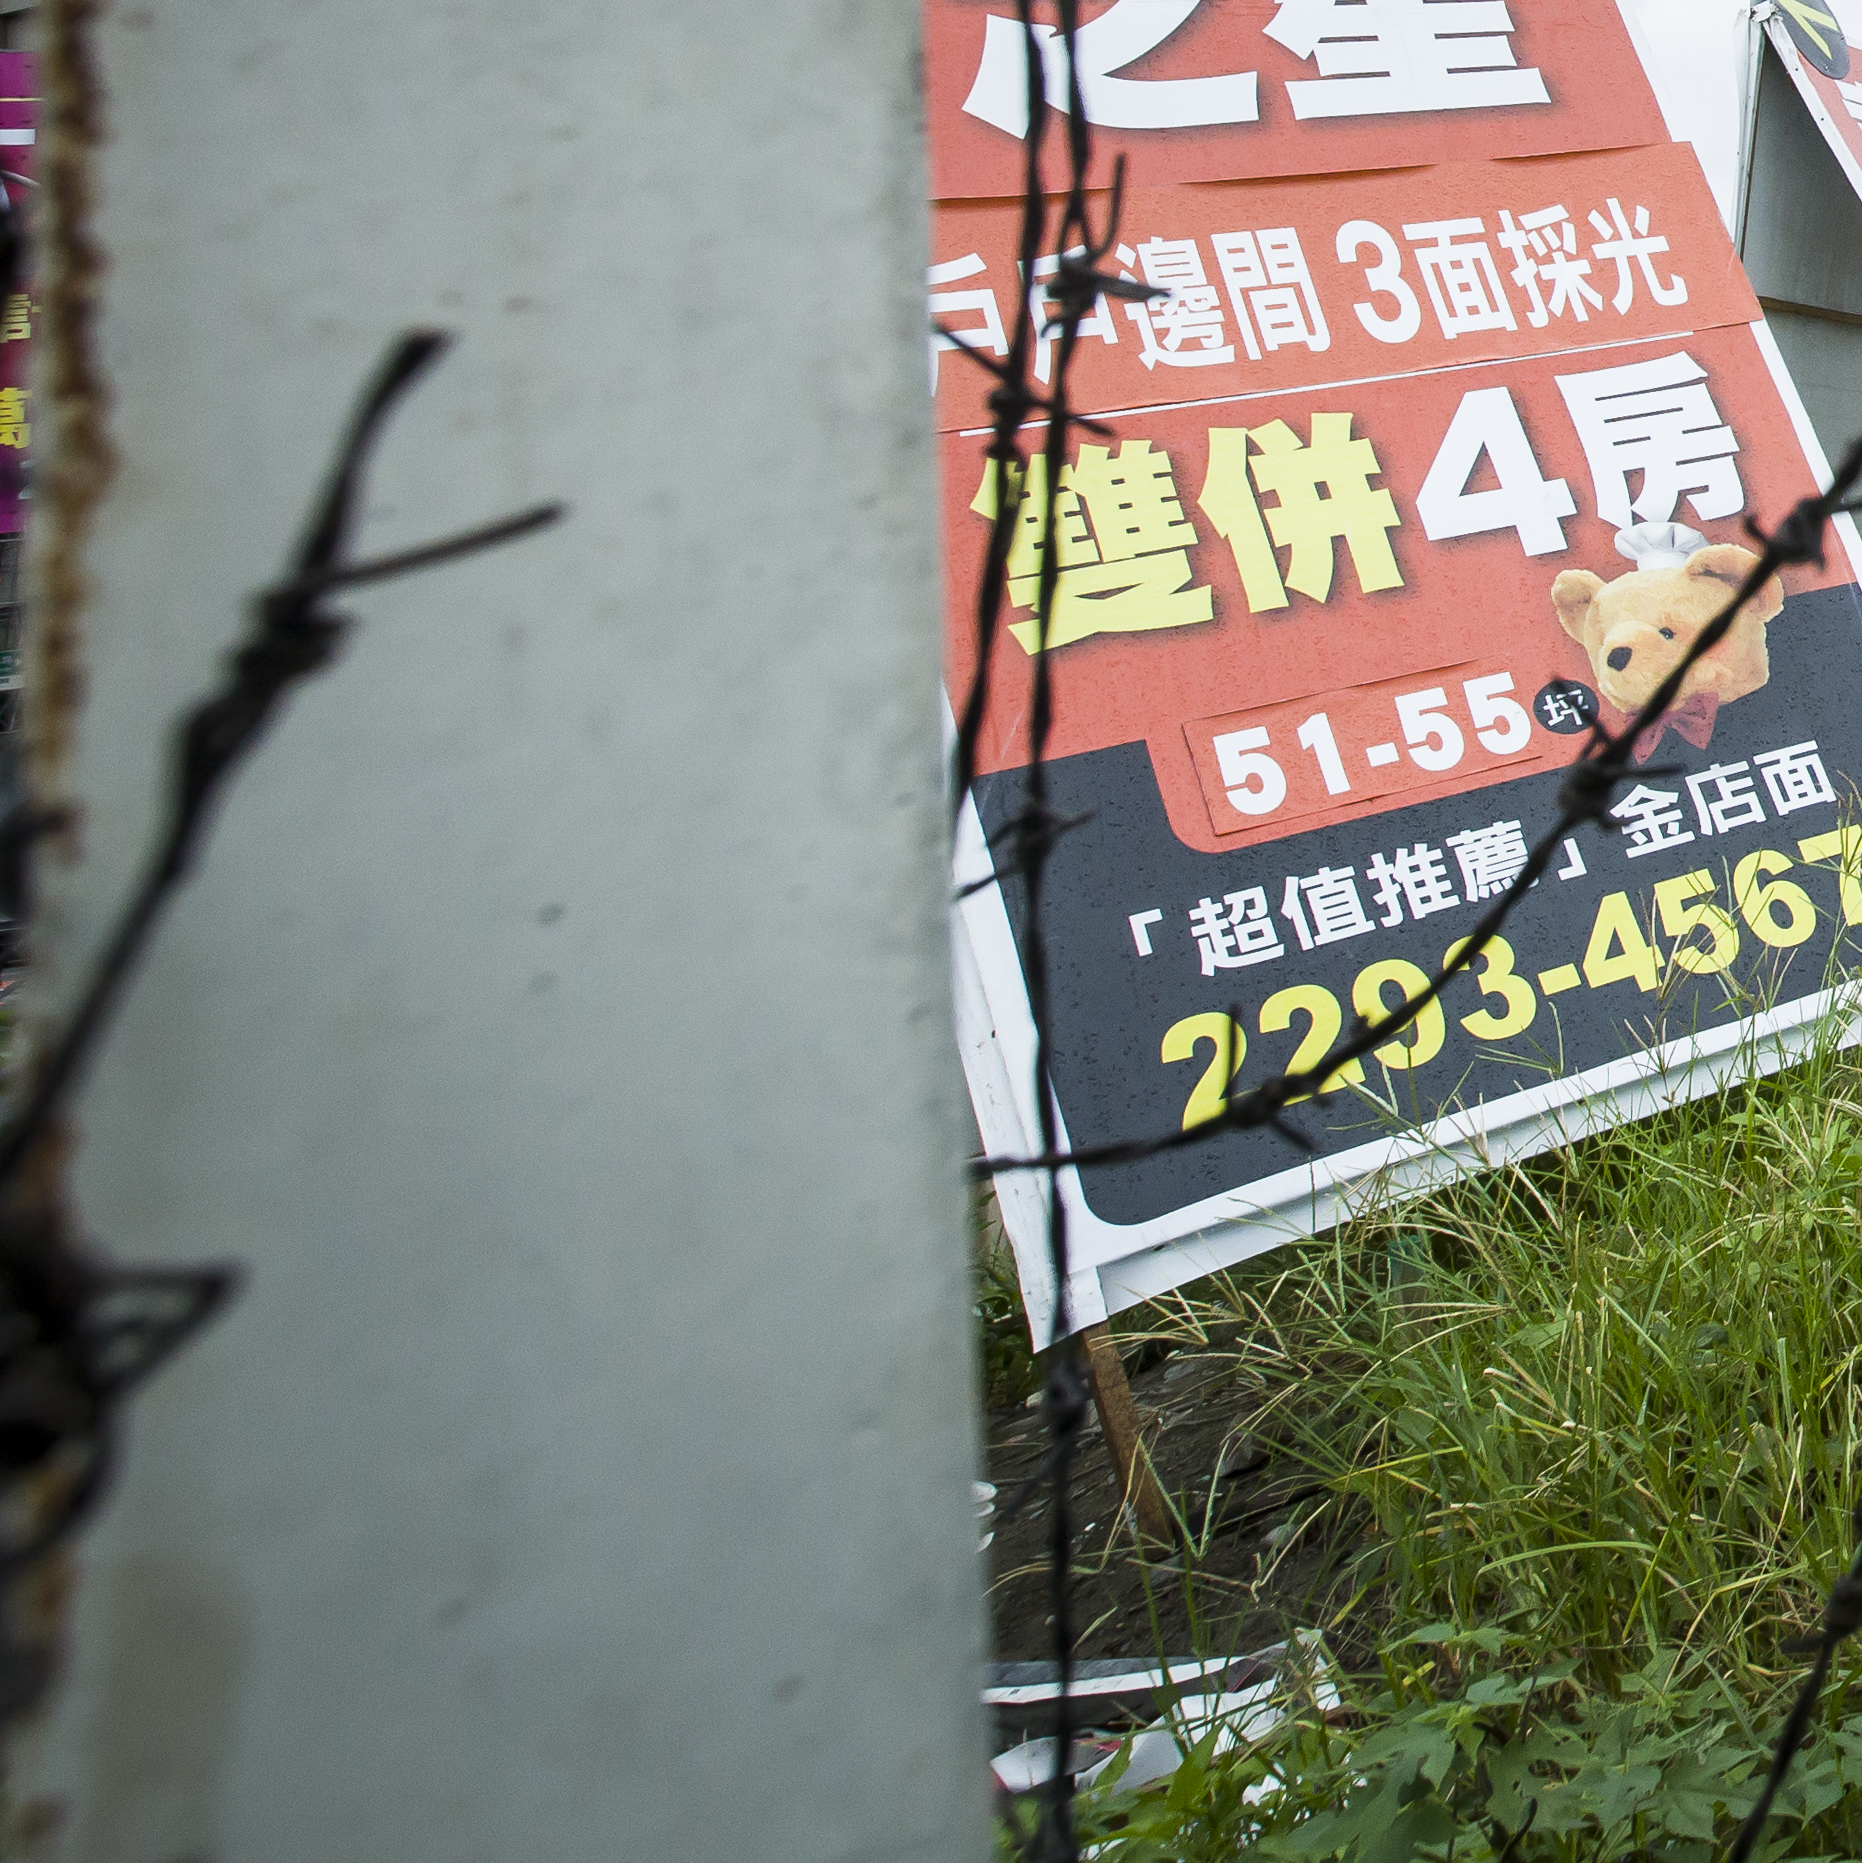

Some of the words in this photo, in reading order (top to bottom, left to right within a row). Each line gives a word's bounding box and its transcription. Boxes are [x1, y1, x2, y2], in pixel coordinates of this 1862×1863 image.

[1336, 198, 1689, 345] 3面採光
[970, 351, 1744, 656] 雙併4房
[1212, 671, 1591, 816] 51-55坪
